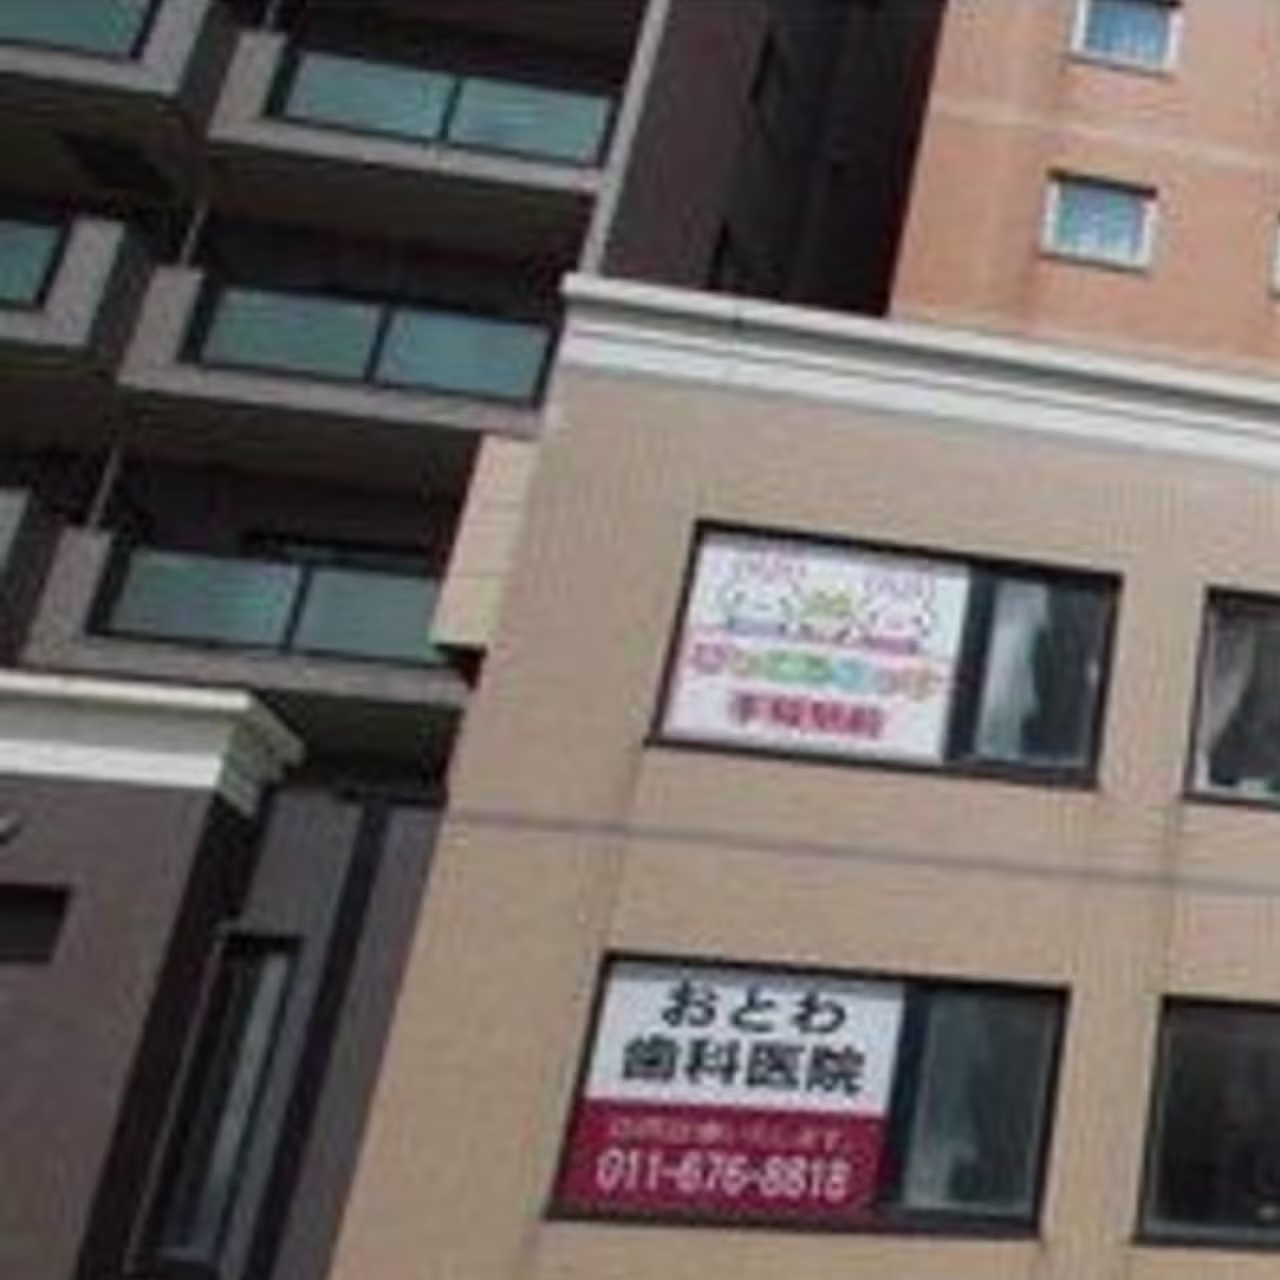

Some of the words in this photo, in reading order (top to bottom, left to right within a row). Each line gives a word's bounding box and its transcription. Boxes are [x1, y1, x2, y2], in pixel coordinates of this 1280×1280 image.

[660, 977, 847, 1034] おとわ
[622, 1033, 866, 1097] 歯科医院
